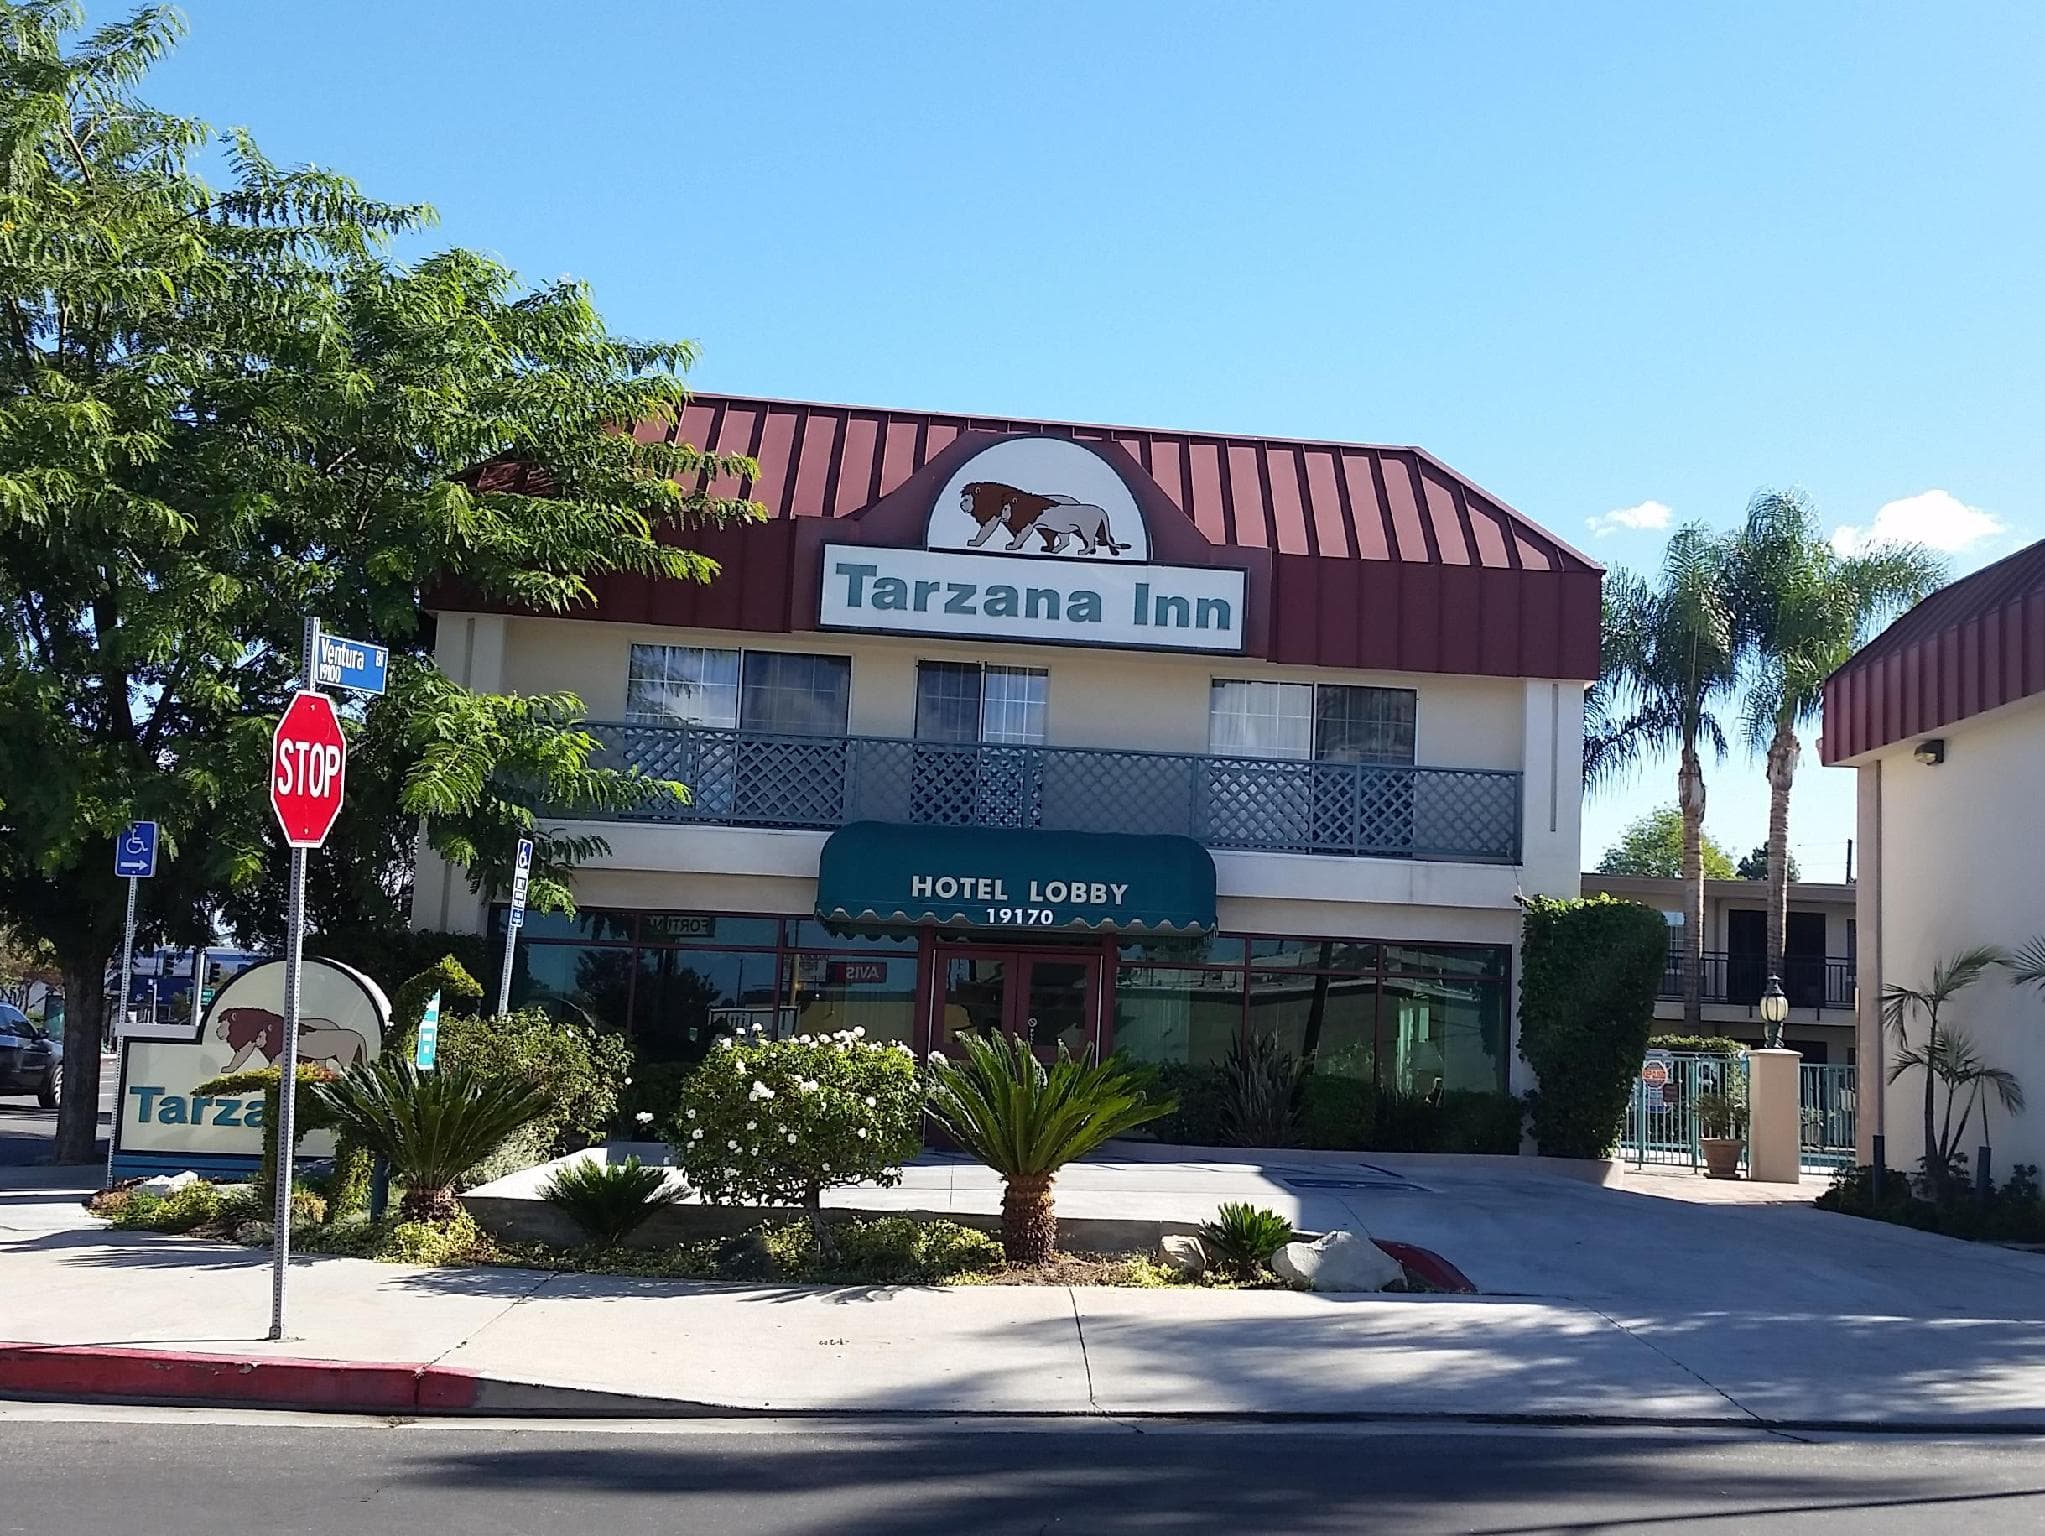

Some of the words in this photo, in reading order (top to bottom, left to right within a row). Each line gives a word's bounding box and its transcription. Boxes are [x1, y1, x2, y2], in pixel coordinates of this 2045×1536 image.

[836, 563, 1103, 623] Tarzana
[1133, 582, 1232, 631] Inn
[320, 637, 365, 671] Ventura
[319, 663, 342, 683] 19100
[277, 737, 341, 799] STOP
[911, 875, 1008, 901] HOTEL
[1029, 880, 1129, 905] LOBBY
[986, 908, 1054, 926] 19170
[129, 1085, 267, 1128] Tarza
